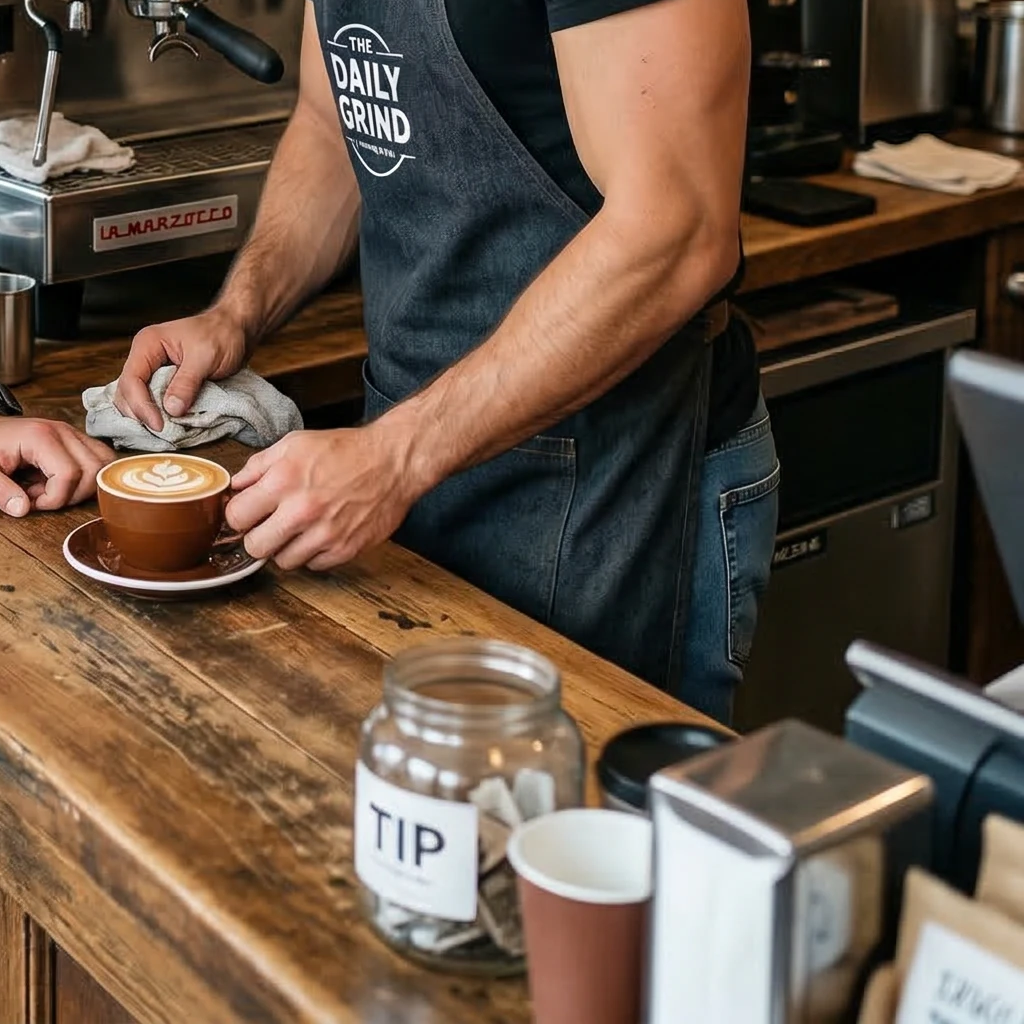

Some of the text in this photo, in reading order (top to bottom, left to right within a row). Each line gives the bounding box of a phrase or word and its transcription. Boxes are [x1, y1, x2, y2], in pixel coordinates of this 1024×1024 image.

[349, 36, 373, 54] THE
[330, 52, 400, 102] DAILY
[338, 94, 411, 144] GRIND
[370, 801, 445, 866] TIP
